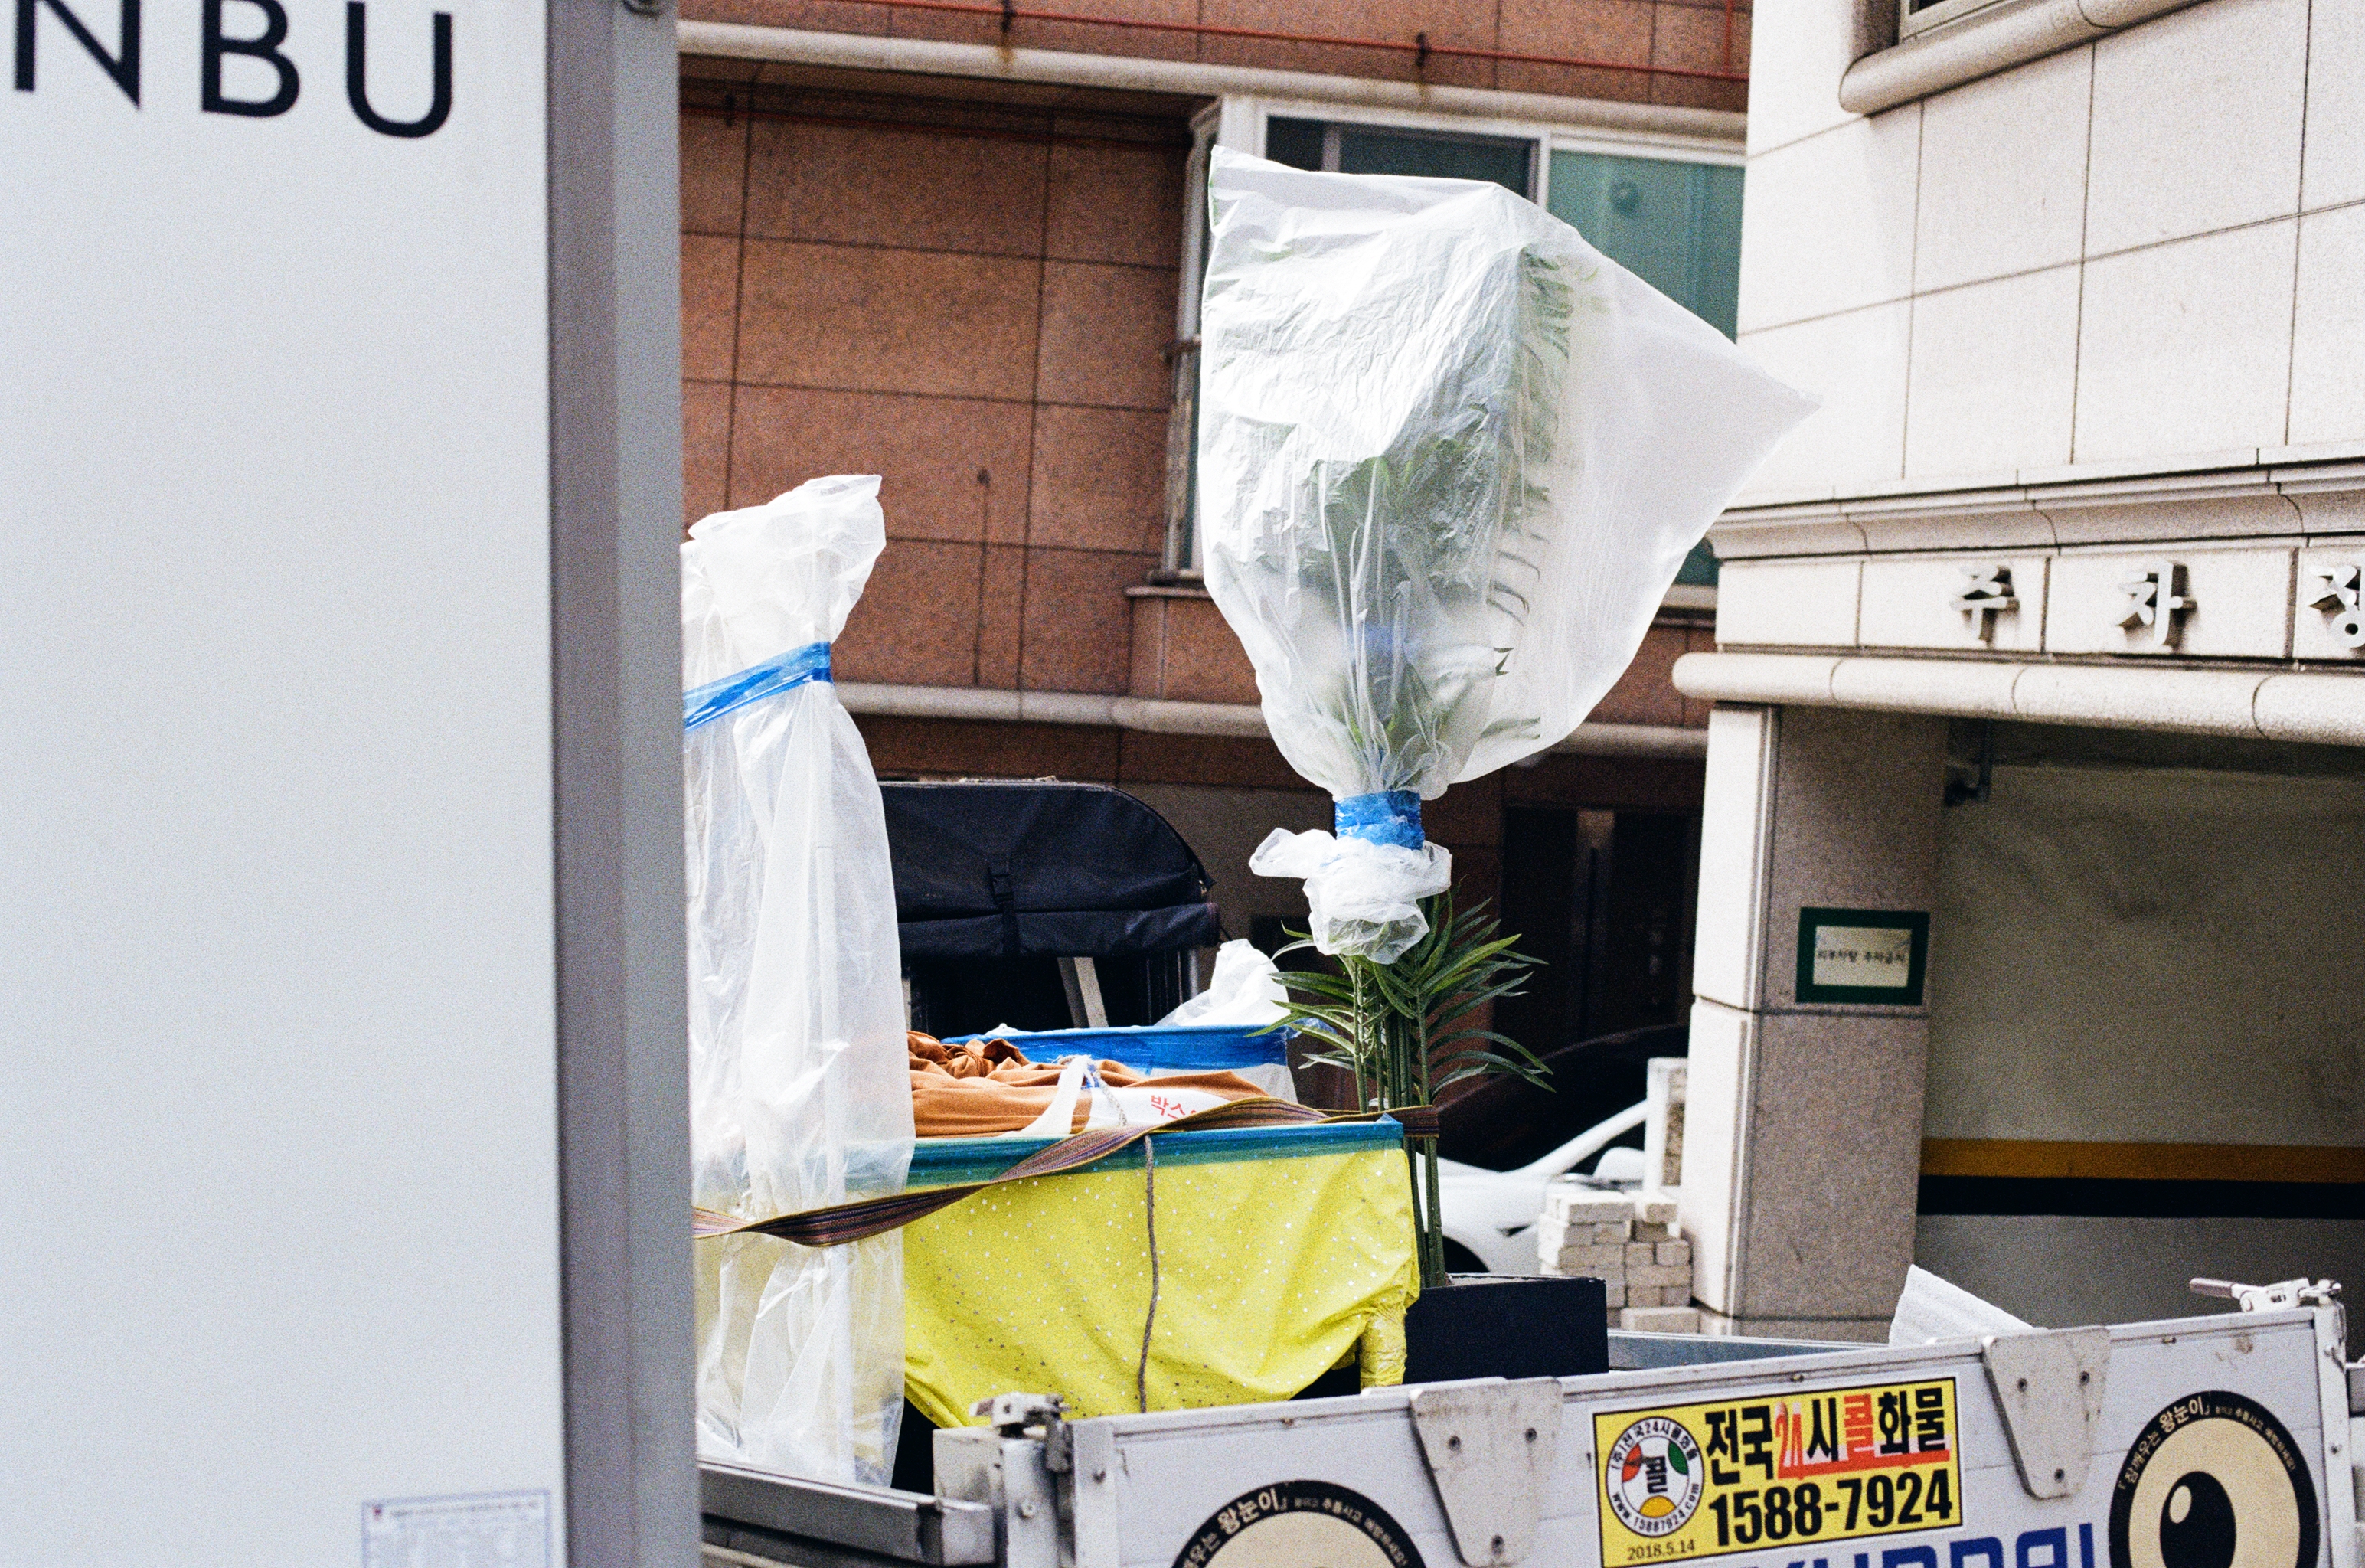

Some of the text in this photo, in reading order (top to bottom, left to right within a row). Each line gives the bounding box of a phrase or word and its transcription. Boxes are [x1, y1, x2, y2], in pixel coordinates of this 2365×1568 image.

[15, 0, 452, 139] NBU
[1150, 1094, 1197, 1119] 박스
[1709, 1468, 1952, 1547] 1588-7924
[1627, 1539, 1695, 1560] 2018.5.14
